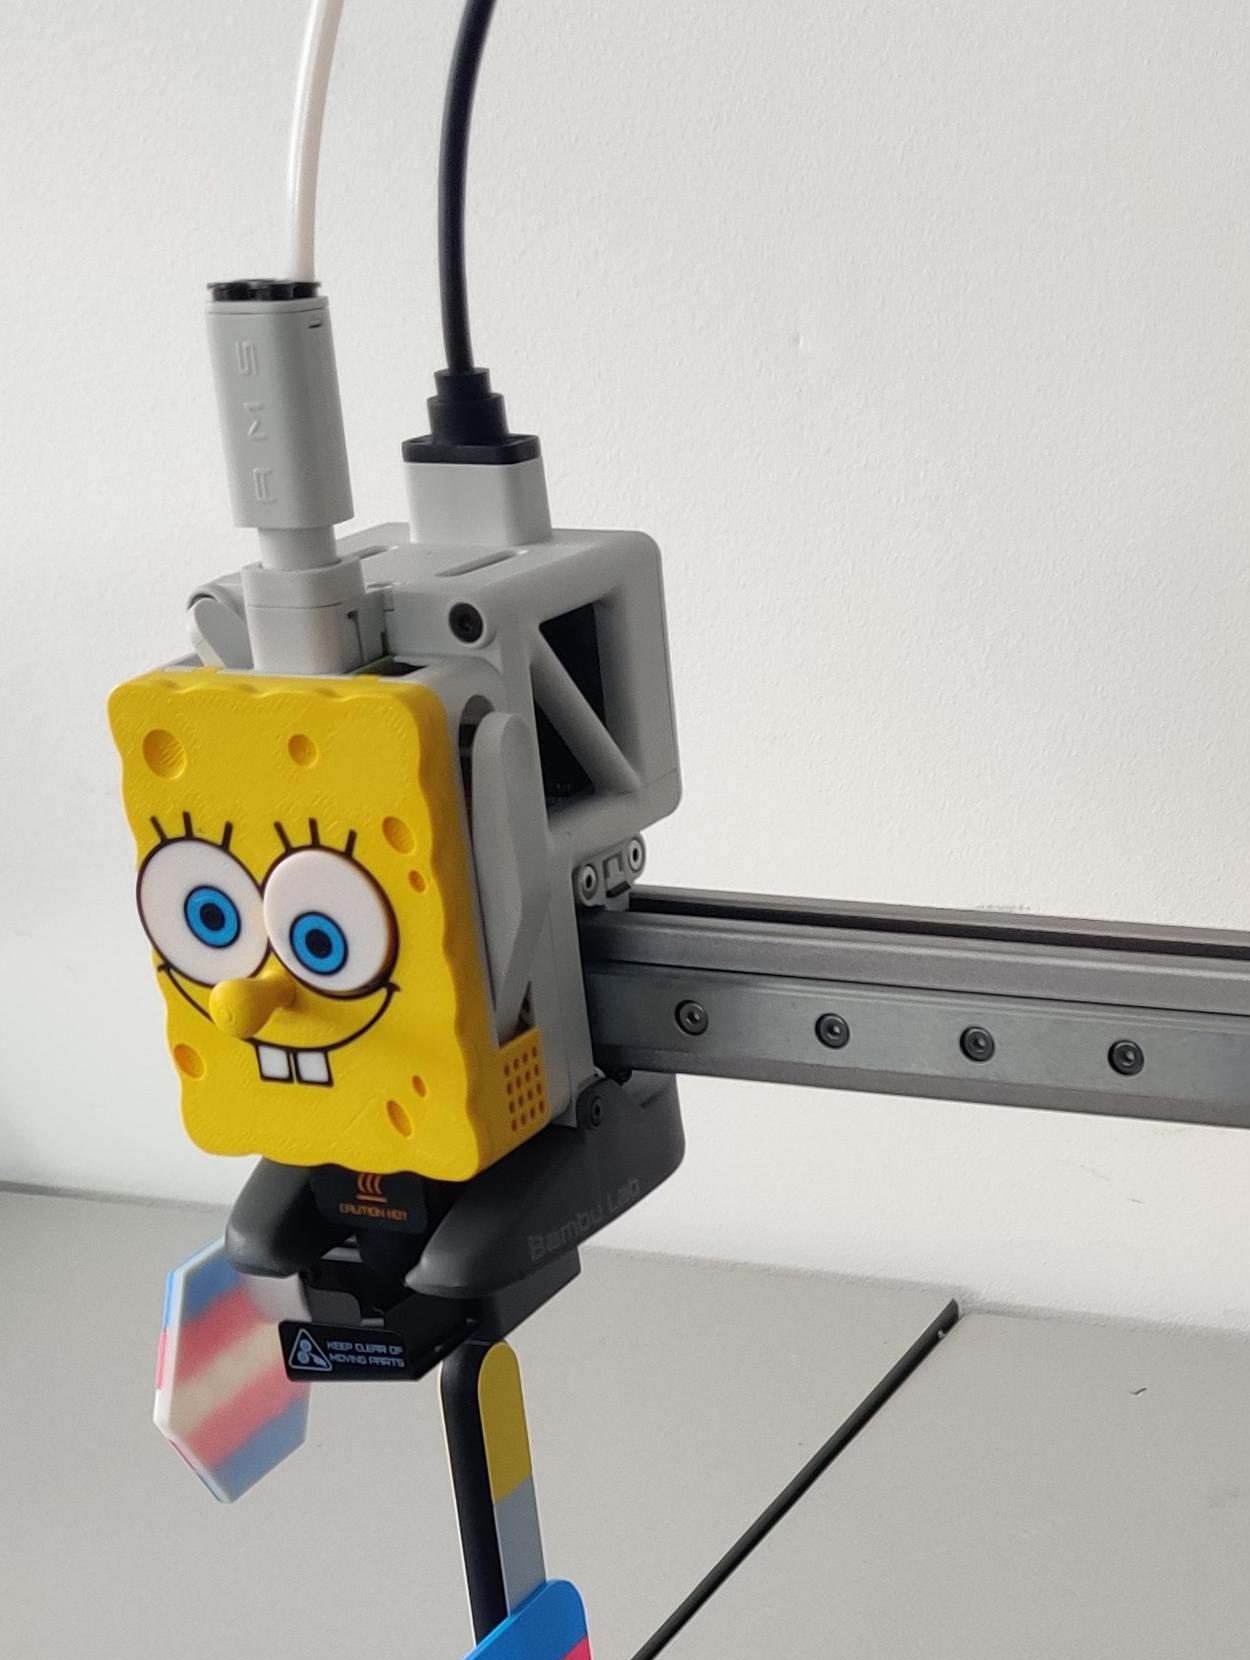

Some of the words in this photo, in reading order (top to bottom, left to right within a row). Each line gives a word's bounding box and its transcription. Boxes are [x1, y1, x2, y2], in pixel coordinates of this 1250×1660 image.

[527, 1206, 602, 1262] Bambu
[606, 1177, 642, 1212] Lab
[327, 1341, 353, 1351] KEEP
[355, 1343, 386, 1354] CLEAR
